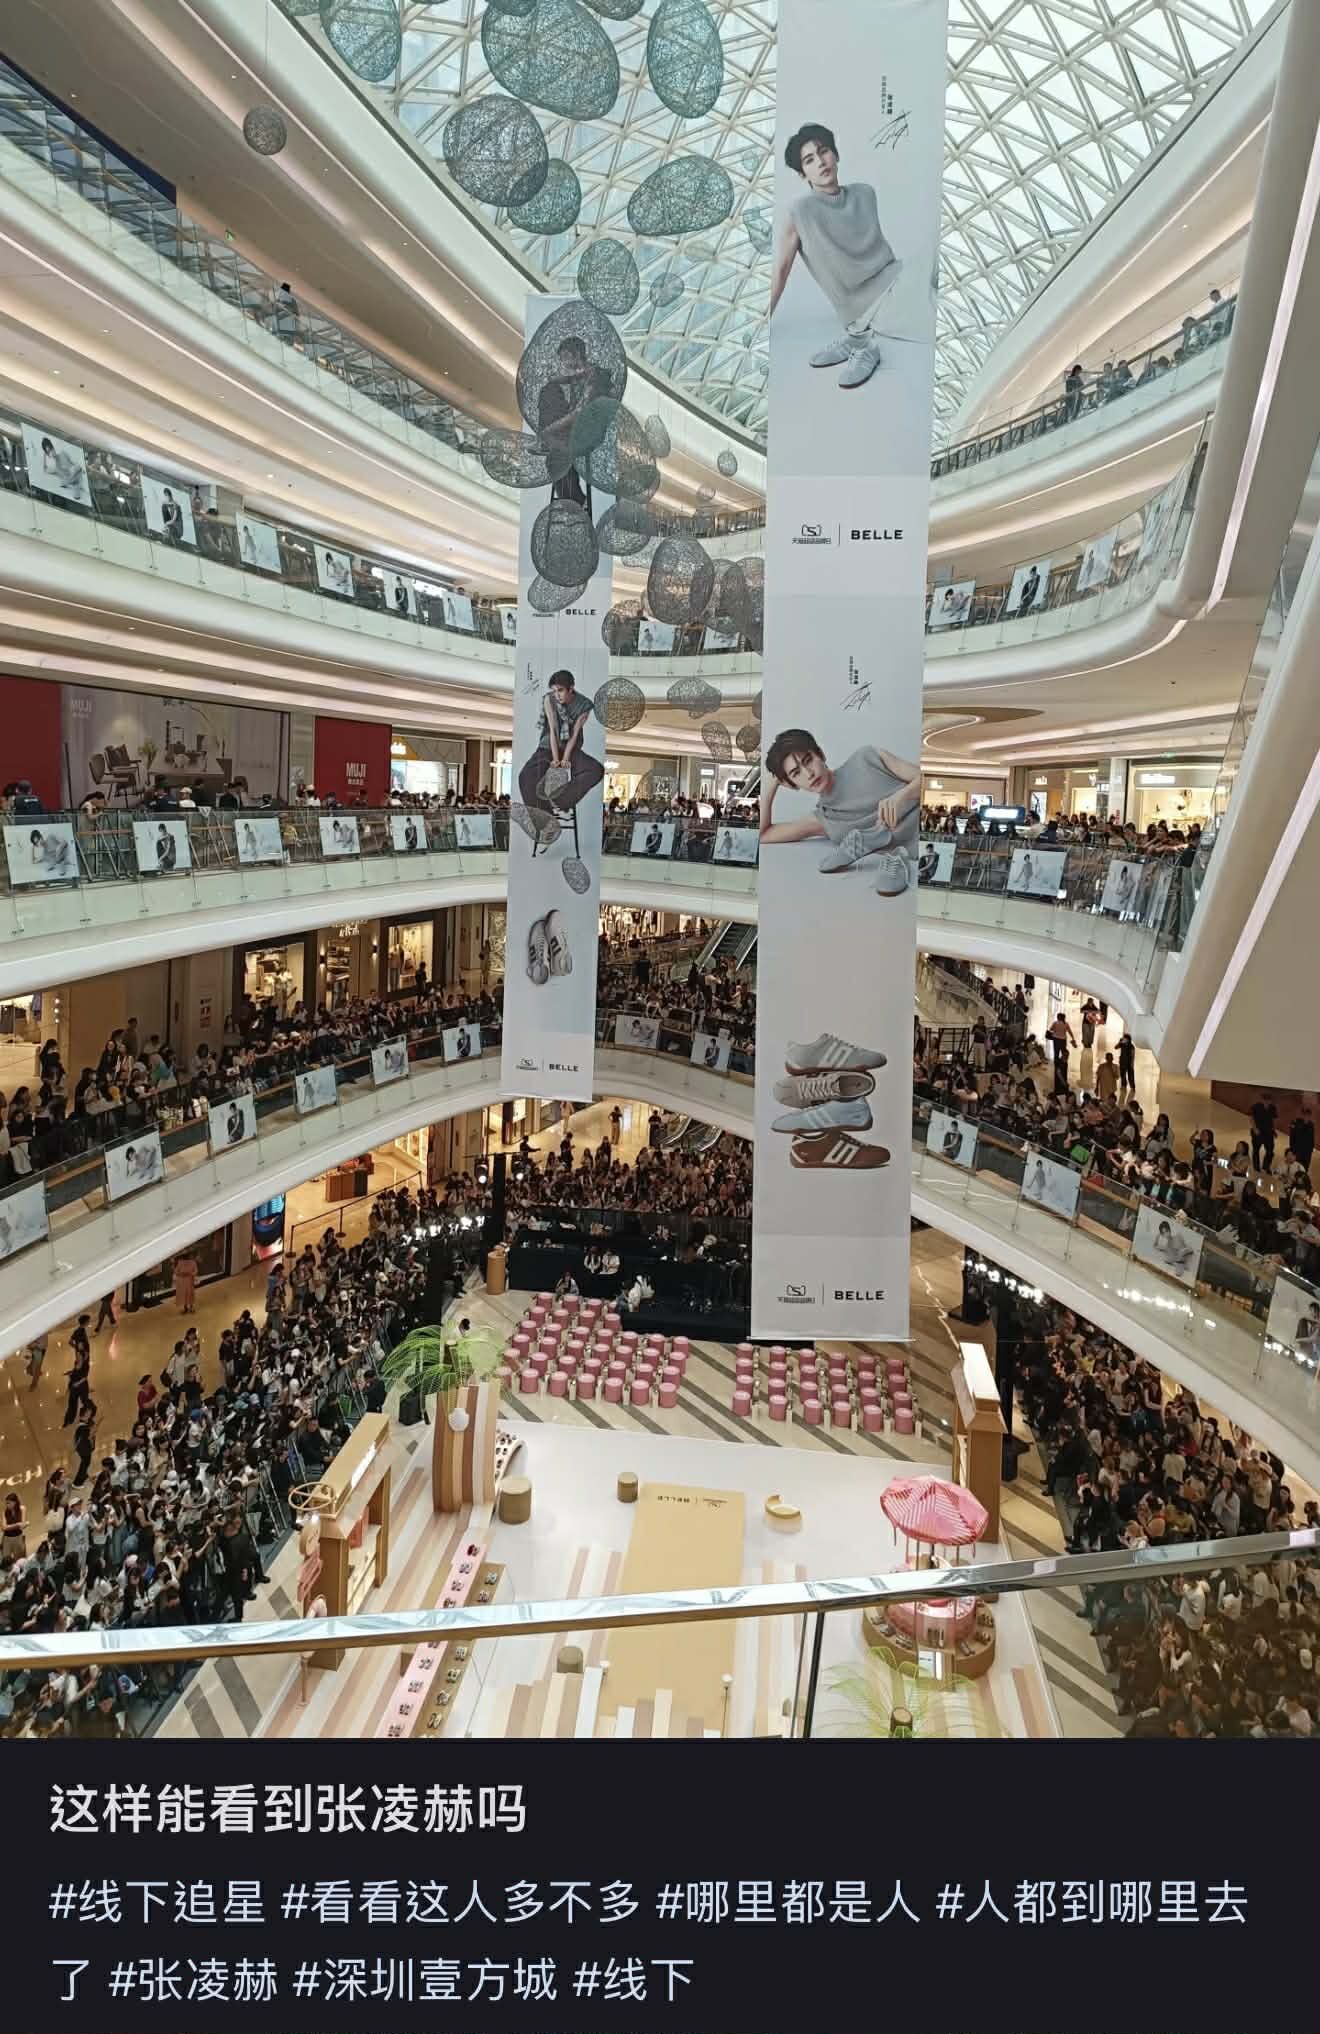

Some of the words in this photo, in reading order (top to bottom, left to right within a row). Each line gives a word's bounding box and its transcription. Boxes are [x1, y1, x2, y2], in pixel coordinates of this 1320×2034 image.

[850, 529, 904, 540] BELLE
[565, 608, 596, 616] BELLE
[345, 762, 367, 778] MUJI
[549, 1063, 579, 1072] BELLE
[834, 1290, 885, 1301] BELLE
